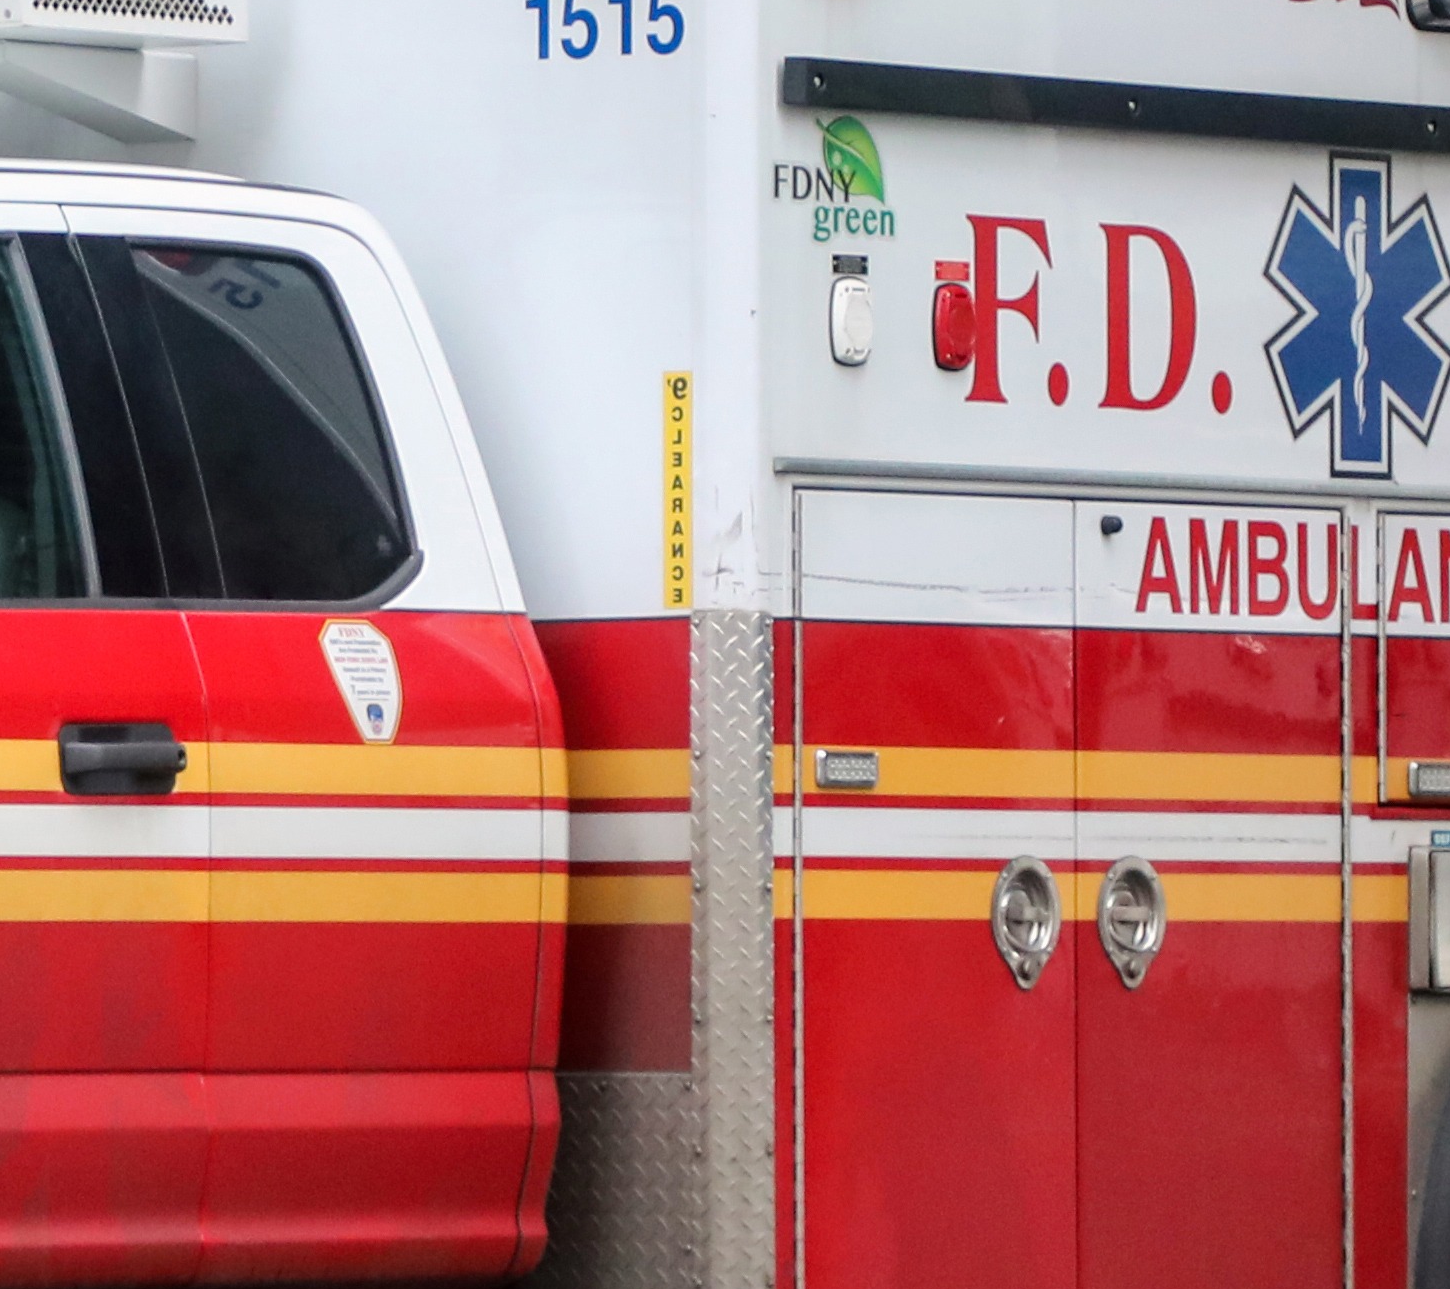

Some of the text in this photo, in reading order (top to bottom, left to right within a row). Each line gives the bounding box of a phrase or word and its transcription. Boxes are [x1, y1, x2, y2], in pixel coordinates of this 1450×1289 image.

[773, 163, 857, 204] FDNY
[813, 205, 896, 243] green
[965, 213, 1232, 416] F.D.
